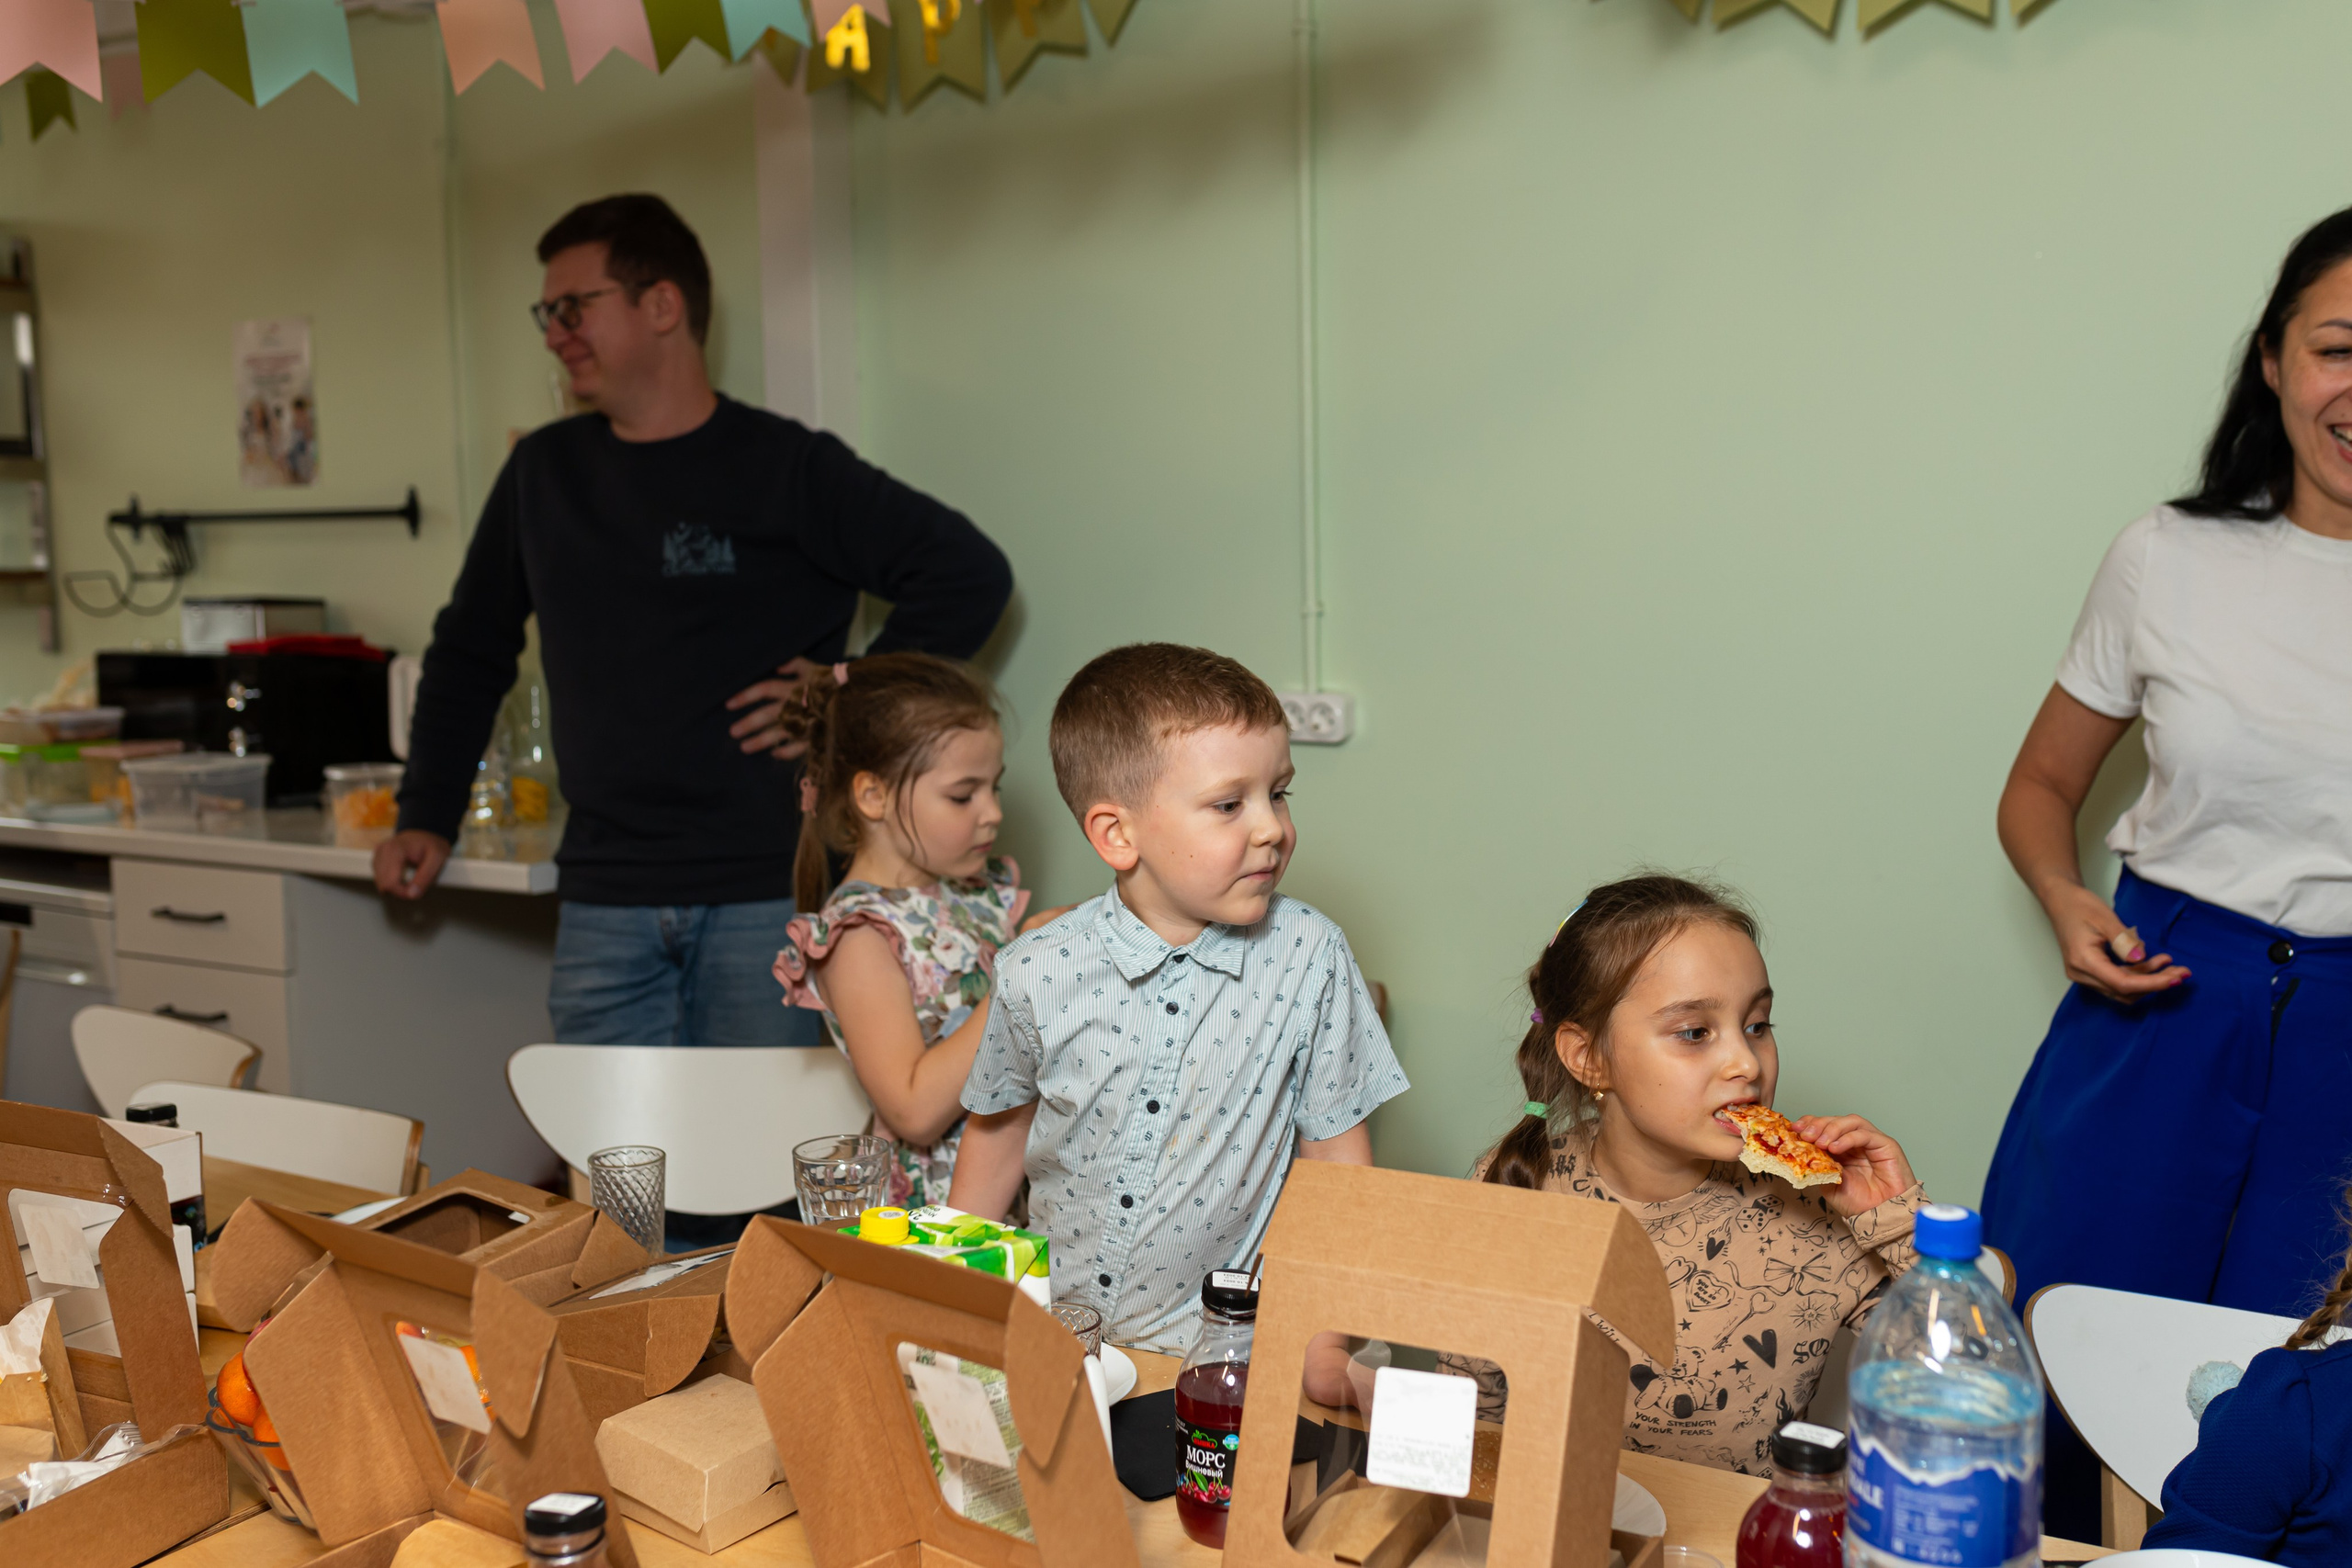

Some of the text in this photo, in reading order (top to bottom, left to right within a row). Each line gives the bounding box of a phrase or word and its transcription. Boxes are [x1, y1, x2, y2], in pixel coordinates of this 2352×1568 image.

[1634, 1411, 1717, 1427] YOUR STRENGTH
[1629, 1421, 1641, 1429] IN
[1647, 1426, 1673, 1435] YOUR
[1186, 1444, 1226, 1469] МОРС
